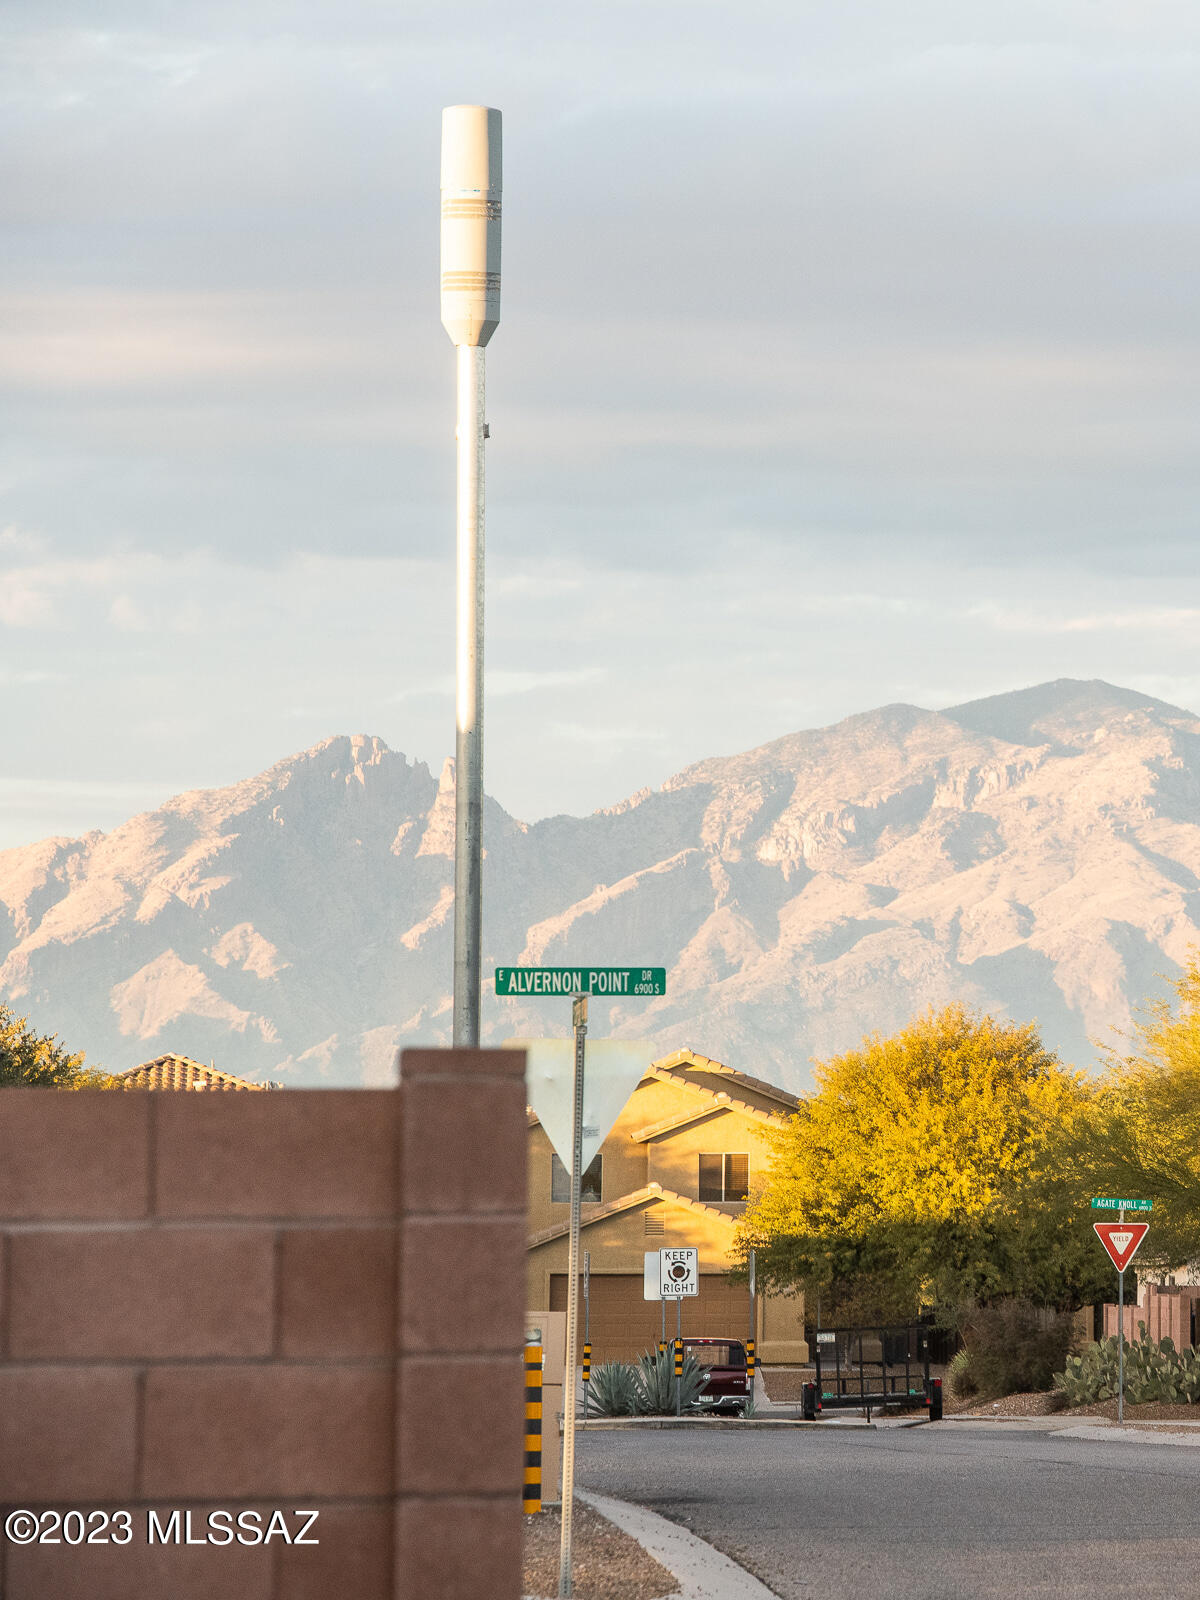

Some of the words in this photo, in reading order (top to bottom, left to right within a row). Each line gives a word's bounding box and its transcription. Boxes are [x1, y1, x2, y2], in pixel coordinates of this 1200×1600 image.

[499, 970, 504, 981] E
[508, 972, 582, 993] ALVERNON
[589, 972, 630, 993] POINT
[642, 970, 652, 981] DR
[634, 983, 653, 994] 6900
[655, 983, 660, 994] S
[1097, 1199, 1116, 1208] AGATE
[1118, 1200, 1137, 1209] KNOLL
[664, 1251, 693, 1261] KEEP
[663, 1283, 695, 1293] RIGHT
